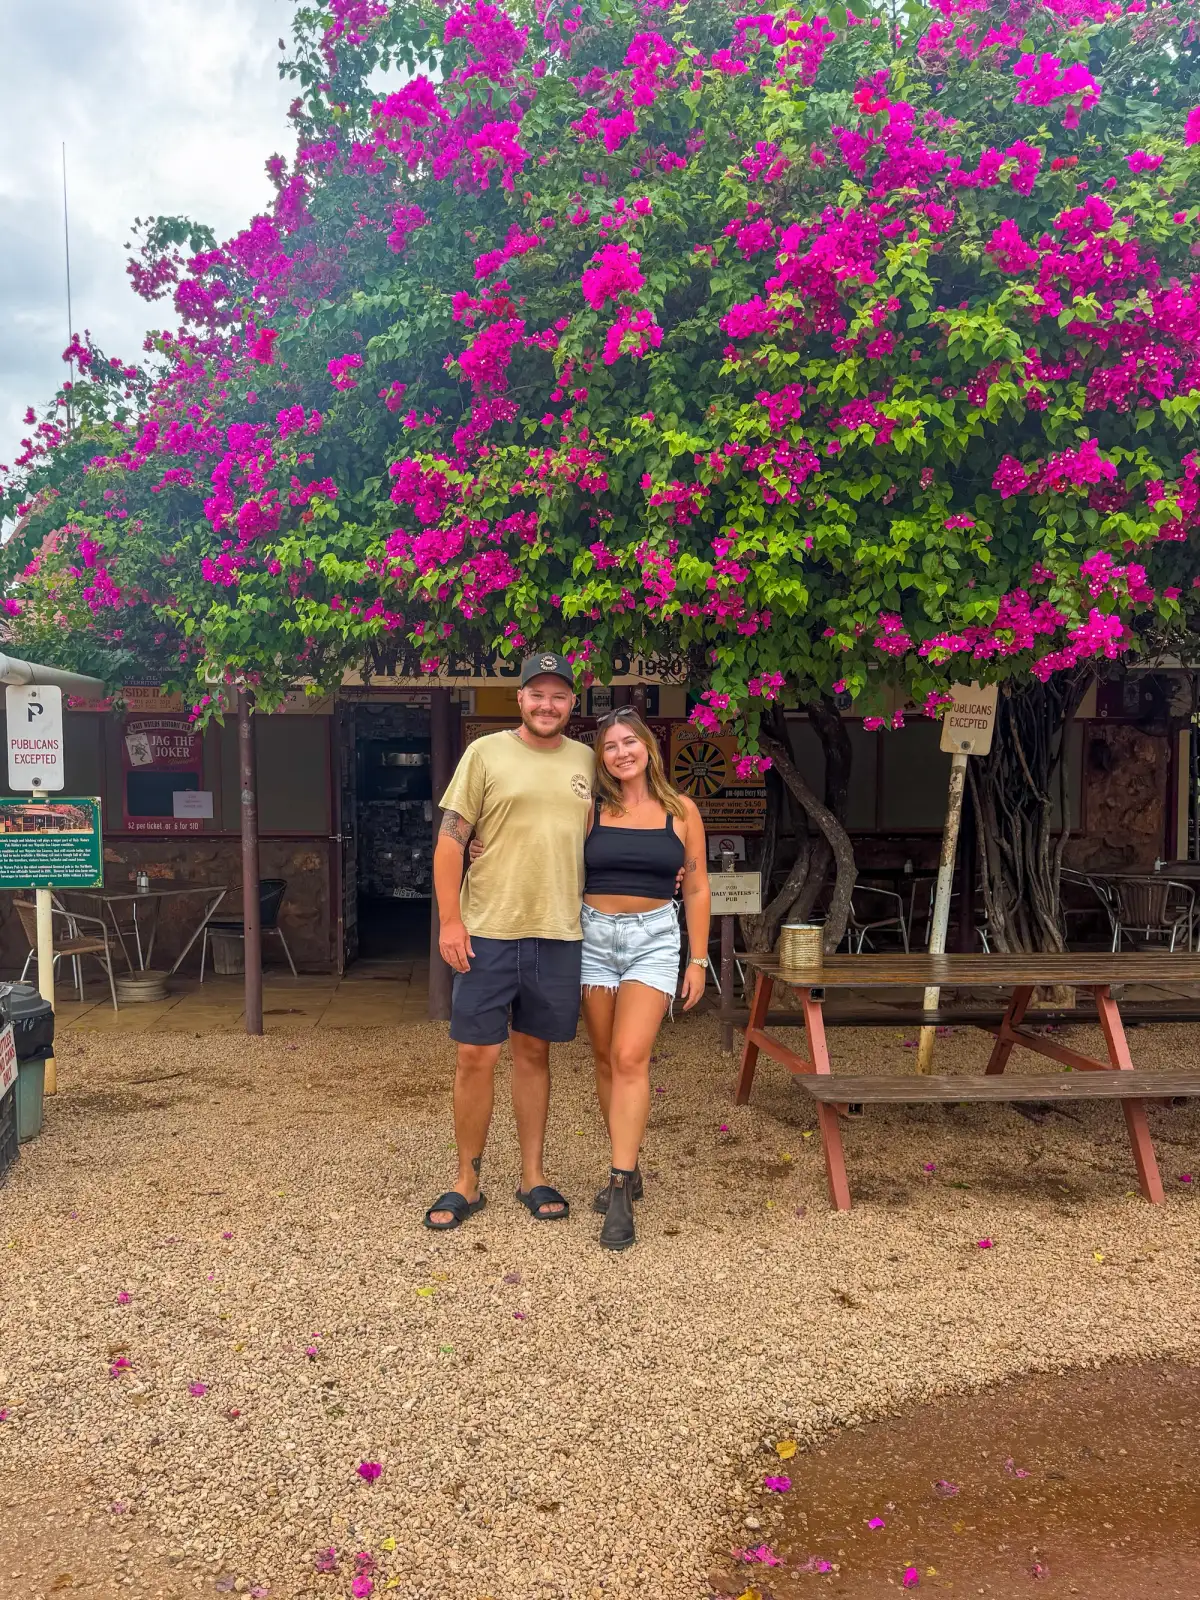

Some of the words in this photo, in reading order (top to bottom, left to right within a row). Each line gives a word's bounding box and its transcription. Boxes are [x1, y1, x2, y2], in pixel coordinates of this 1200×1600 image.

[950, 716, 988, 730] EXCEPTED
[11, 739, 59, 750] PUBLICANS
[151, 736, 170, 746] JAG
[173, 736, 194, 746] THE
[156, 746, 190, 758] JOKER
[14, 754, 56, 764] EXCEPTED
[128, 822, 135, 830] $2
[136, 822, 146, 830] per
[146, 822, 162, 830] ticket
[180, 822, 188, 830] for
[190, 822, 199, 830] $10
